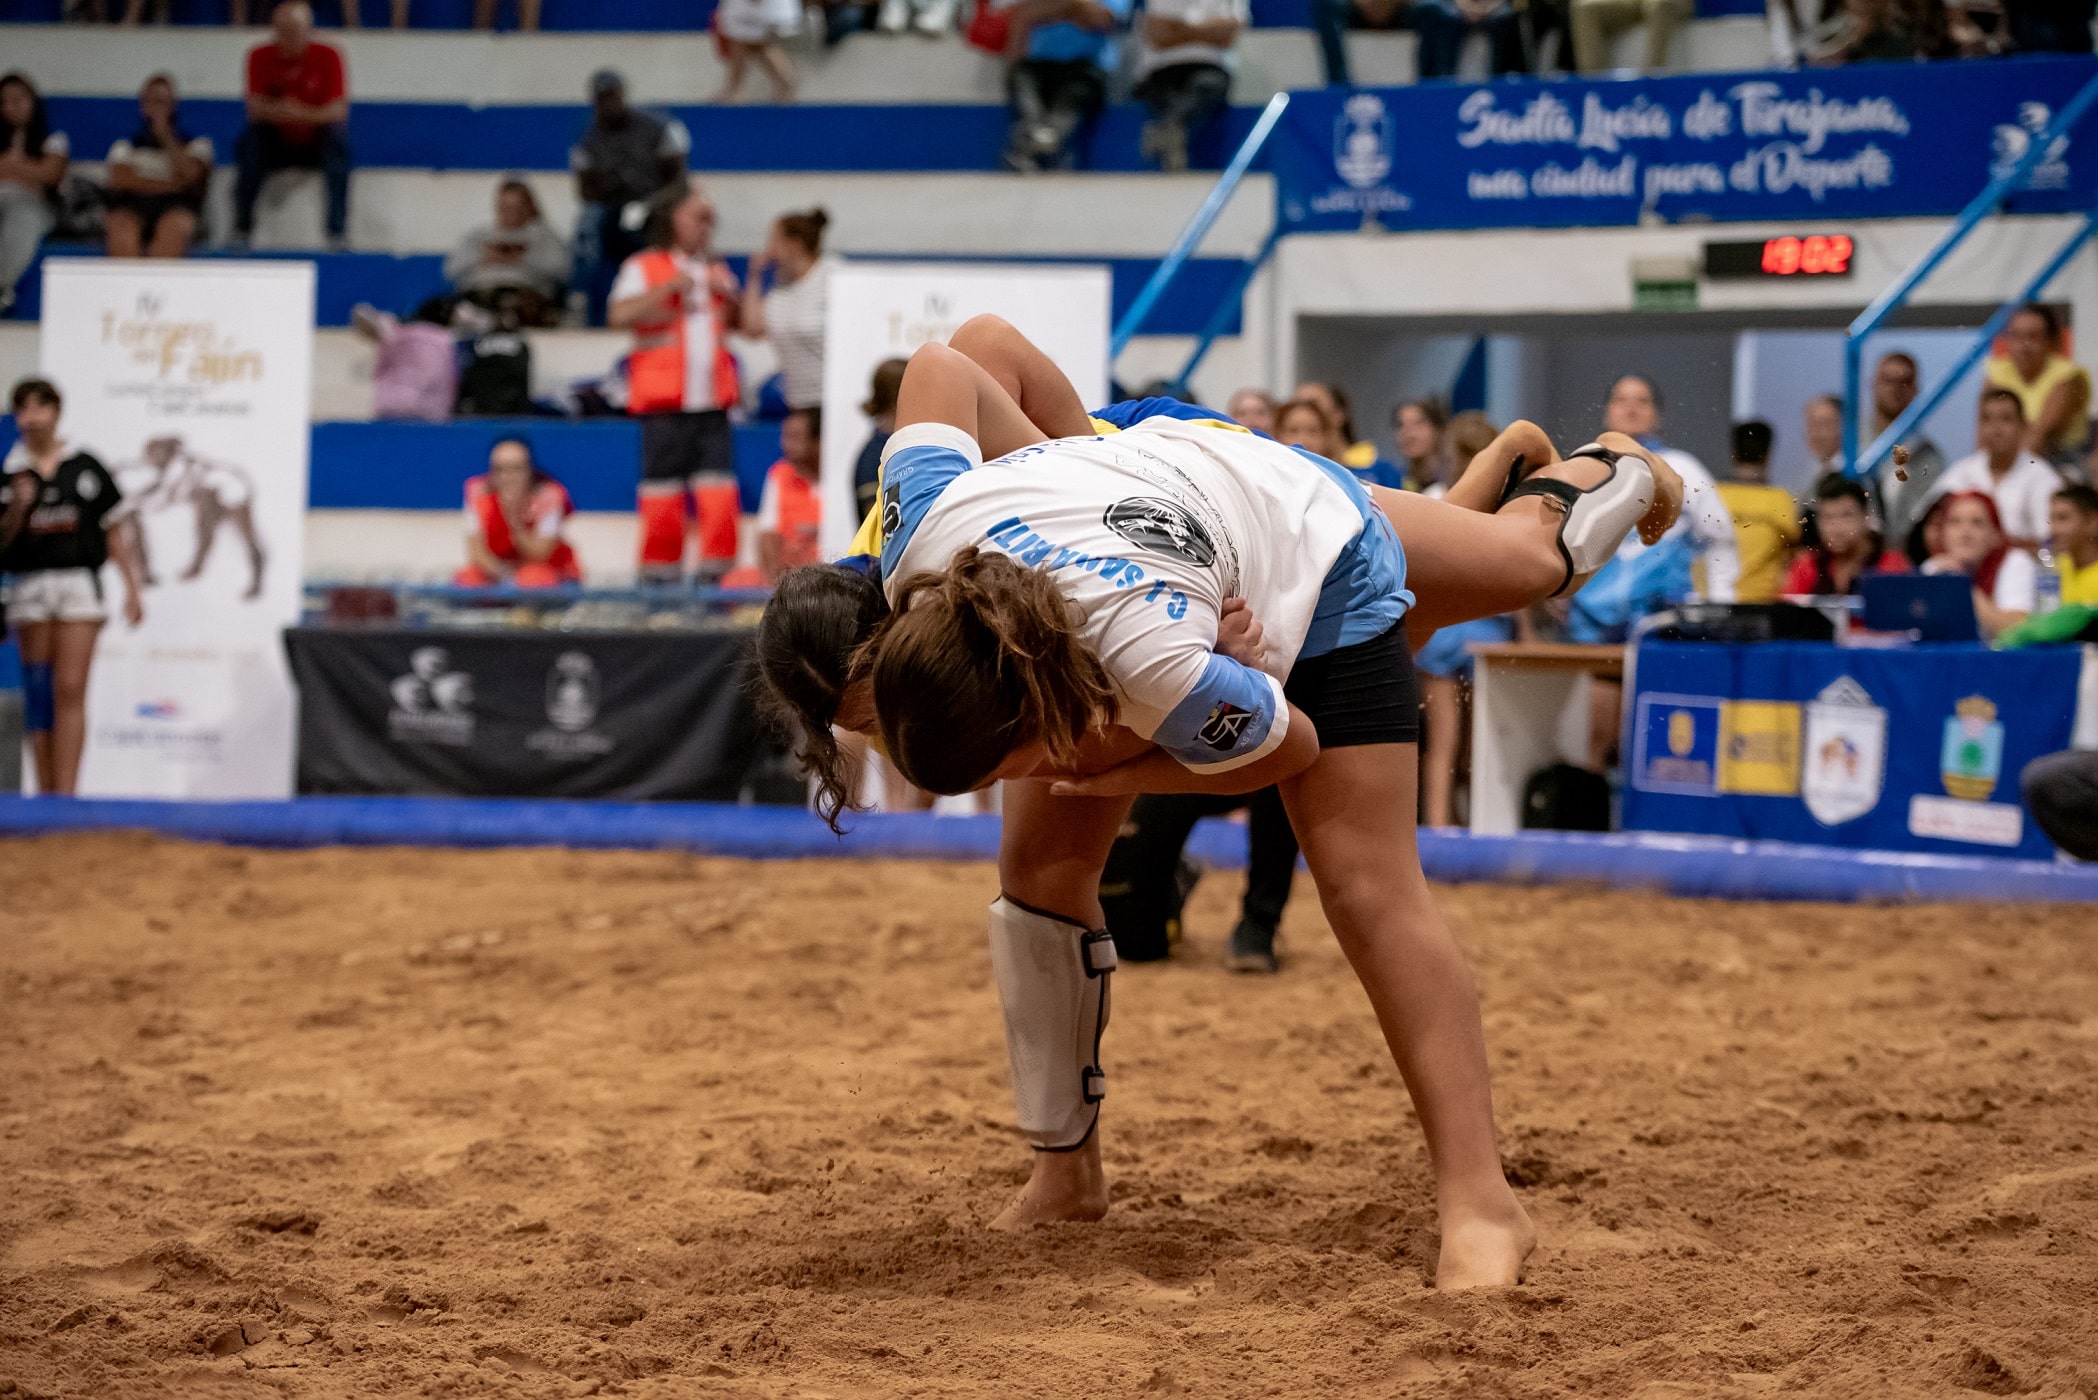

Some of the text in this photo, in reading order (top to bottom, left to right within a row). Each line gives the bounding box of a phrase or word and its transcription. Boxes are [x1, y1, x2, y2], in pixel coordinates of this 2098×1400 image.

[1457, 89, 1576, 148] Santa
[1683, 88, 1731, 140] de
[1531, 153, 1637, 198] ciudad
[1641, 163, 1726, 208] para
[1759, 140, 1893, 202] Deporte
